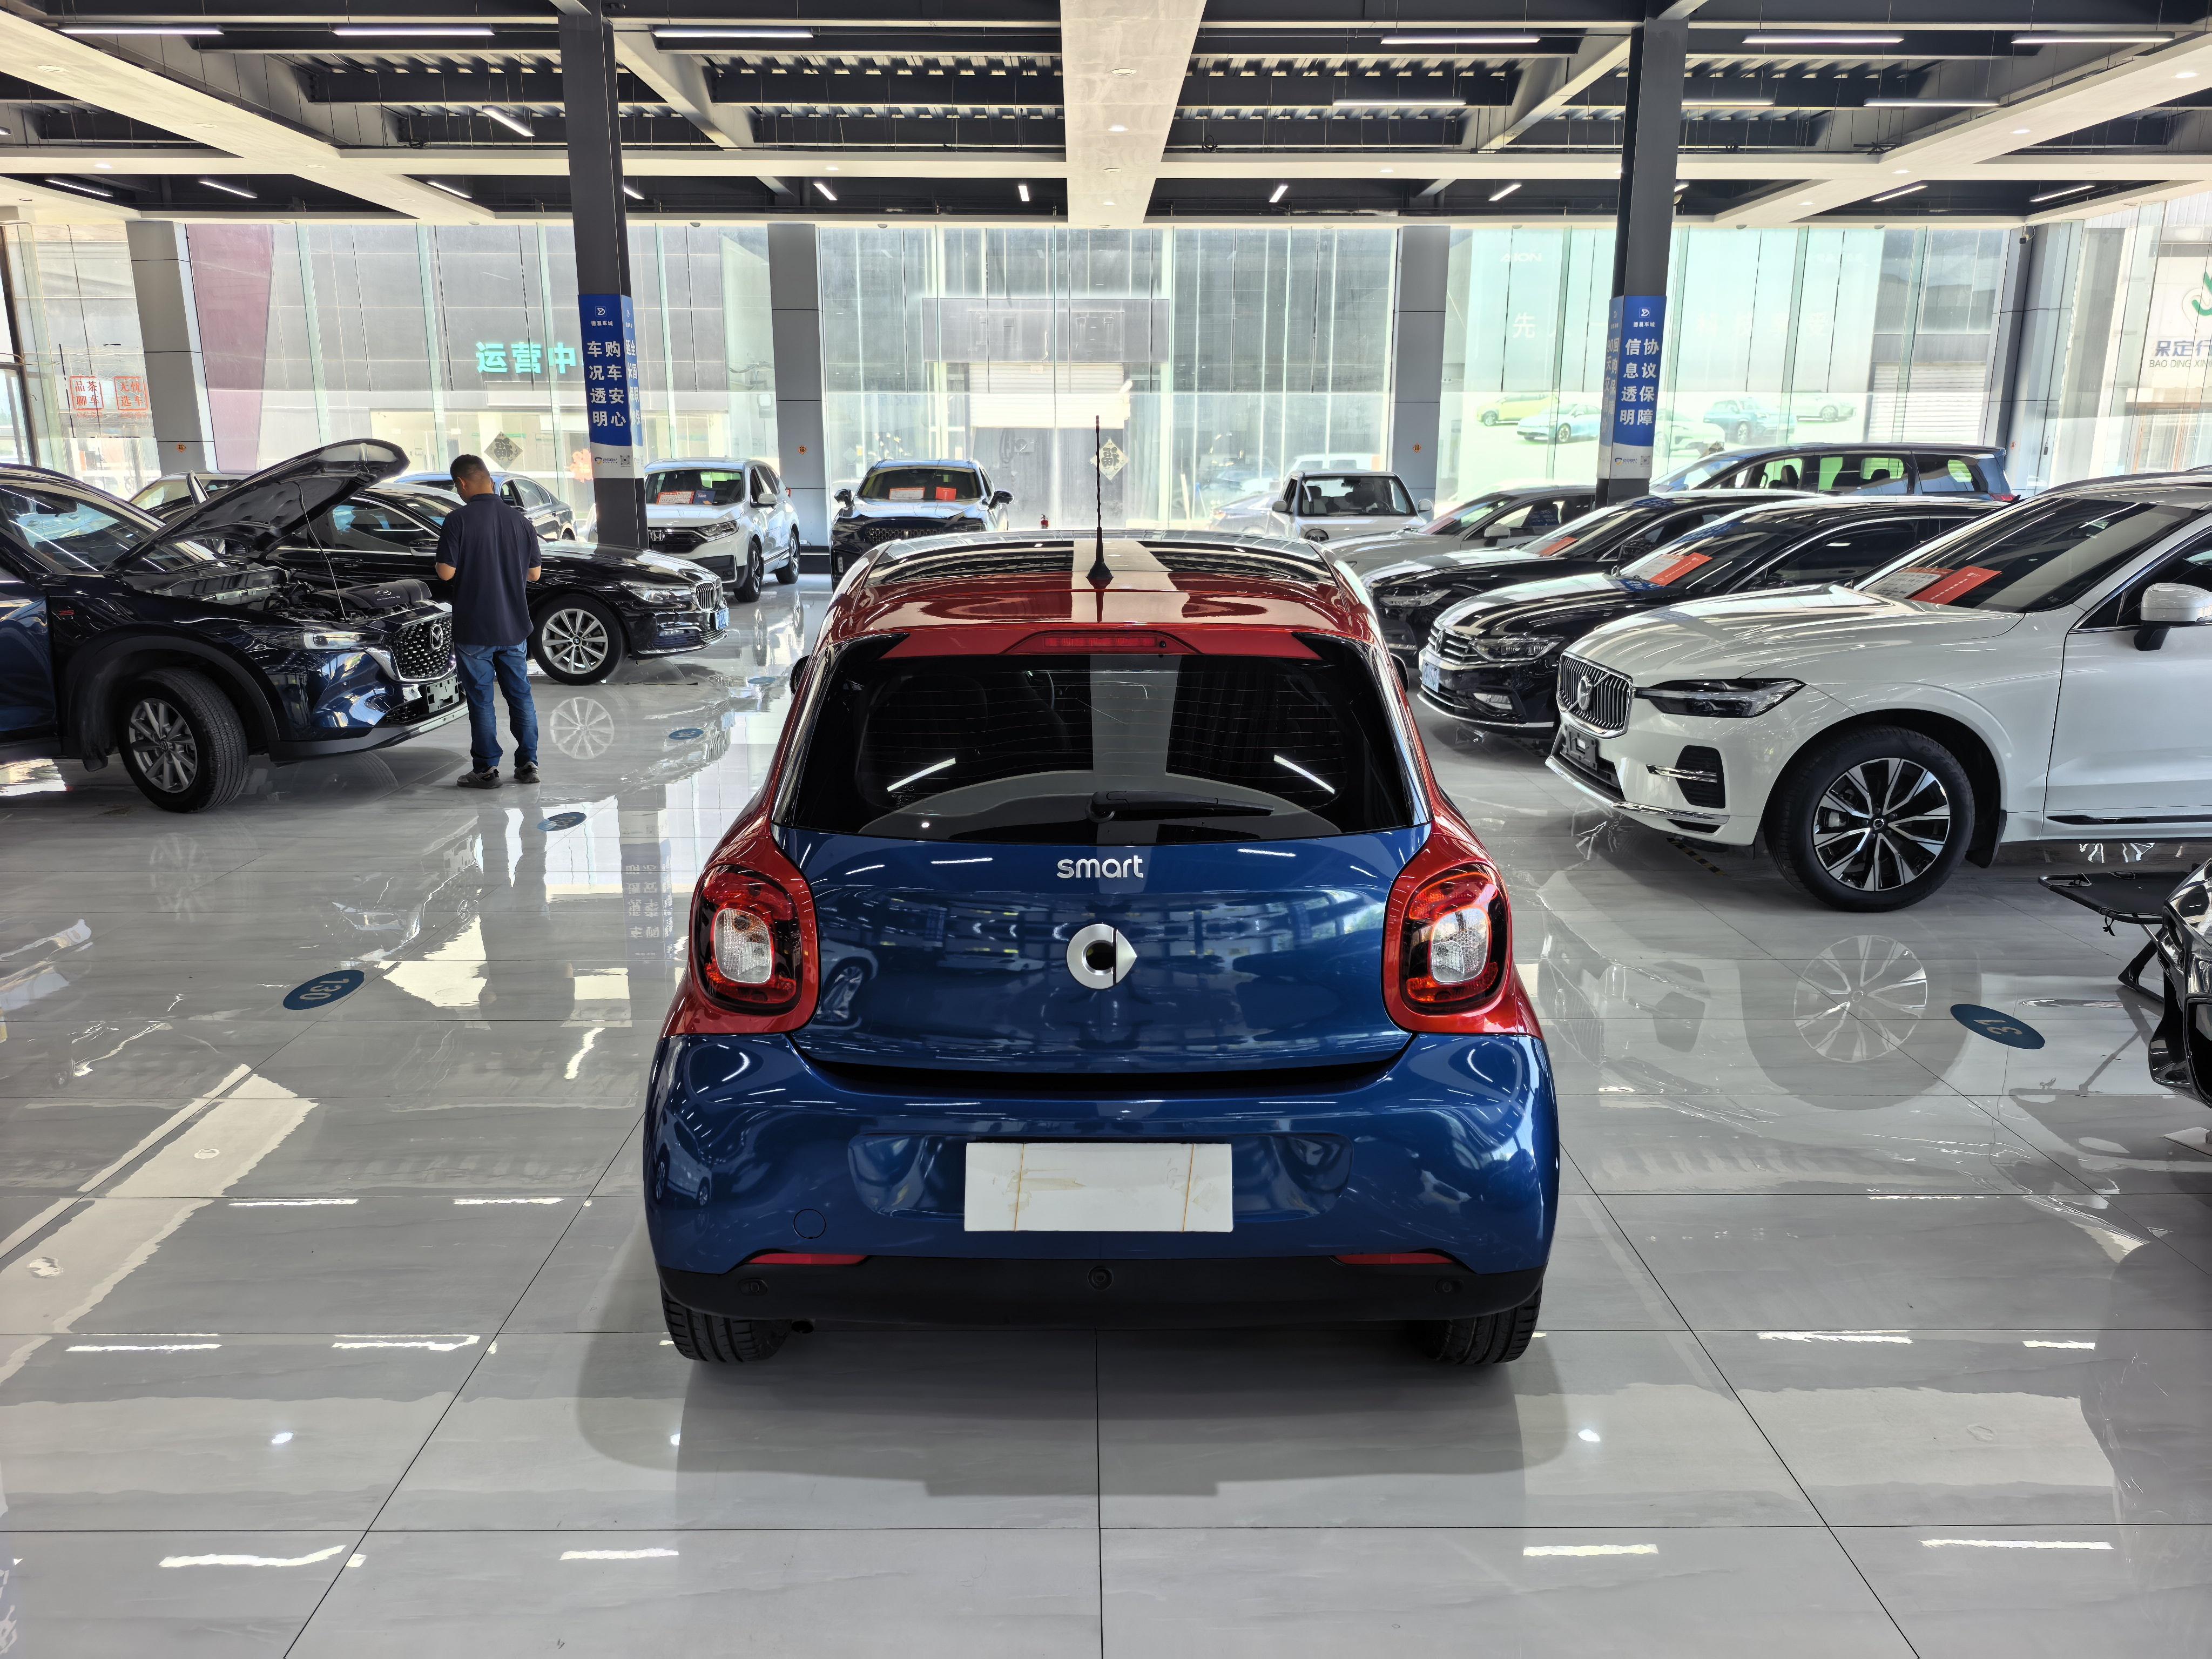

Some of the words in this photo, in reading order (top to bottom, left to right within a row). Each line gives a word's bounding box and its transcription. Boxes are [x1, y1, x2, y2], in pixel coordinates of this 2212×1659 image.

[476, 341, 583, 374] 运营中
[2149, 360, 2168, 368] BAO
[2170, 360, 2191, 368] DING
[587, 341, 608, 427] 车况透明
[605, 341, 626, 427] 购车安心
[1620, 339, 1641, 427] 信息透明
[1637, 339, 1660, 426] 协议保障
[1057, 855, 1143, 879] smart
[299, 979, 350, 1000] 130
[1973, 1020, 2023, 1035] 31
